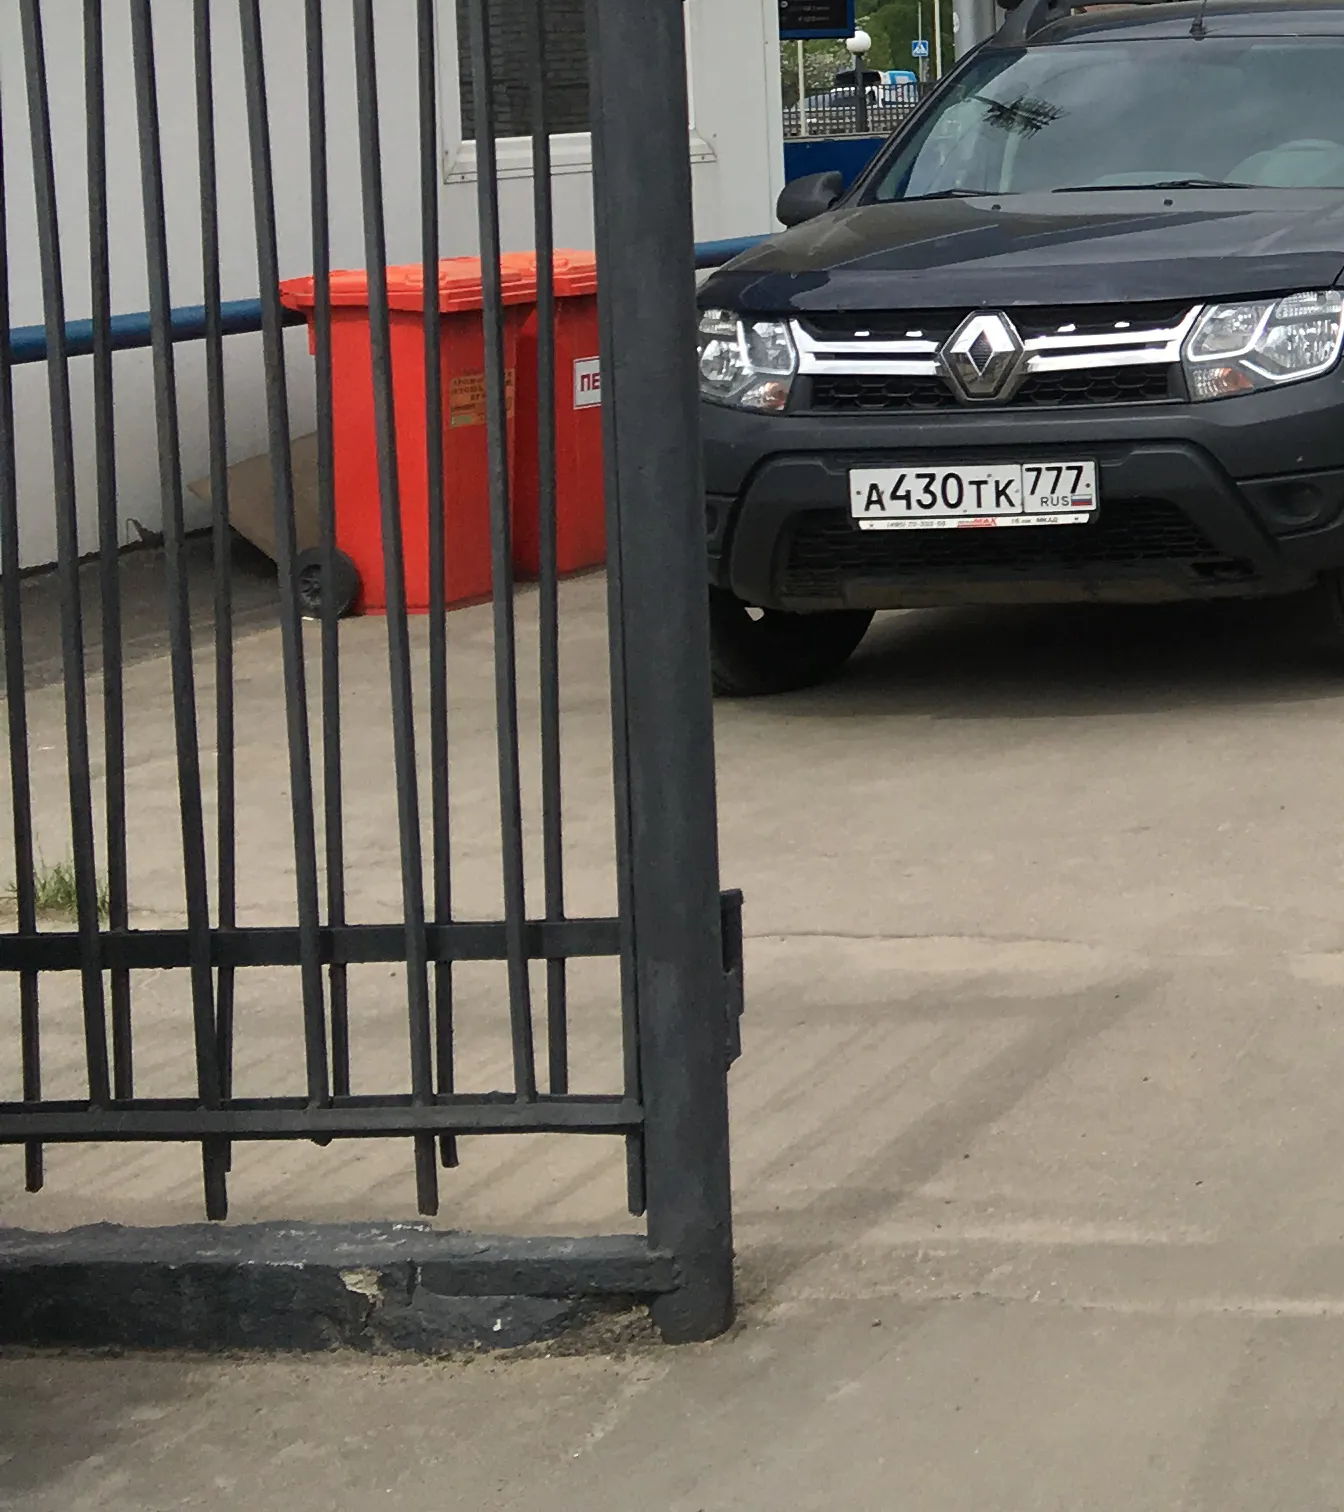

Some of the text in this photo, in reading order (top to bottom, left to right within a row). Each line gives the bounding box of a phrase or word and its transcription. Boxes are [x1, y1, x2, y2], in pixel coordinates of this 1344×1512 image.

[580, 372, 600, 392] ПЕ
[864, 465, 1084, 511] А430ТК 777
[1040, 495, 1070, 506] RUS
